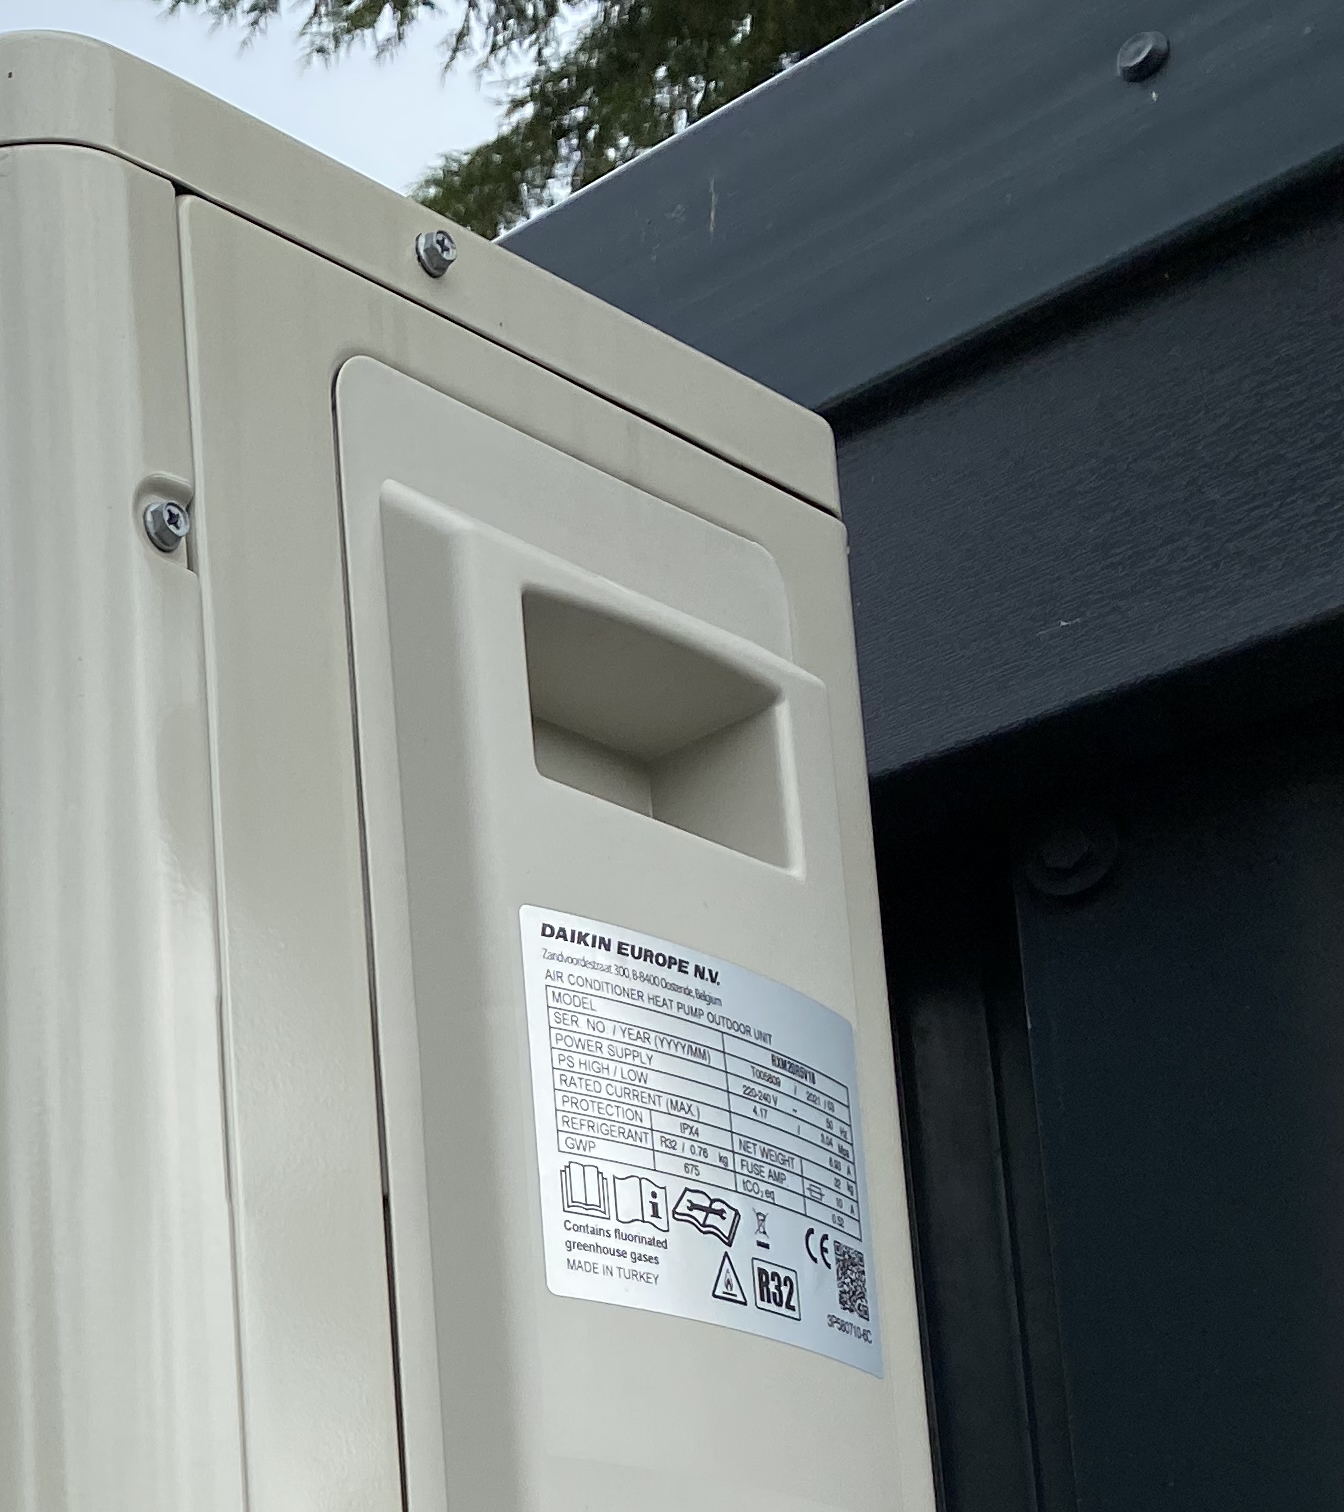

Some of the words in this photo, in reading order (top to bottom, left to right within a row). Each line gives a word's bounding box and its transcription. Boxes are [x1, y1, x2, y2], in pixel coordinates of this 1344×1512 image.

[540, 922, 612, 952] DAIKIN
[616, 940, 689, 974] EUROPE
[694, 964, 721, 986] N.V.
[544, 968, 564, 984] AIR
[567, 973, 645, 1003] CONDITIONER
[647, 993, 675, 1011] HEAT
[676, 1001, 705, 1020] PUMP
[706, 1012, 752, 1038] OUTDOOR
[753, 1027, 773, 1046] UNIT
[551, 990, 597, 1012] MODEL
[555, 1032, 604, 1055] POWER
[607, 1043, 654, 1066] SUPPLY
[619, 1025, 652, 1045] YEAR
[654, 1034, 712, 1065] (YYYY/MM)
[558, 1053, 575, 1068] PS
[578, 1057, 611, 1077] HIGH
[620, 1067, 649, 1085] LOW
[559, 1073, 602, 1094] RATED
[605, 1083, 663, 1108] CURRENT
[665, 1098, 701, 1121] (MAX.)
[562, 1094, 644, 1123] PROTECTION
[562, 1115, 650, 1145] REFRIGERANT
[564, 1136, 596, 1153] GWP
[680, 1122, 699, 1138] IPX4
[660, 1135, 677, 1152] R32
[718, 1152, 729, 1168] kg
[738, 1138, 758, 1159] NET
[759, 1146, 795, 1170] WEIGHT
[683, 1162, 700, 1177] 675
[740, 1158, 766, 1179] FUSE
[563, 1219, 612, 1239] Contains
[614, 1228, 669, 1250] fluorinated
[565, 1239, 628, 1259] greenhouse
[630, 1249, 660, 1266] gases
[566, 1257, 600, 1275] MADE
[602, 1264, 613, 1278] IN
[616, 1266, 660, 1286] TURKEY
[757, 1266, 796, 1312] R32
